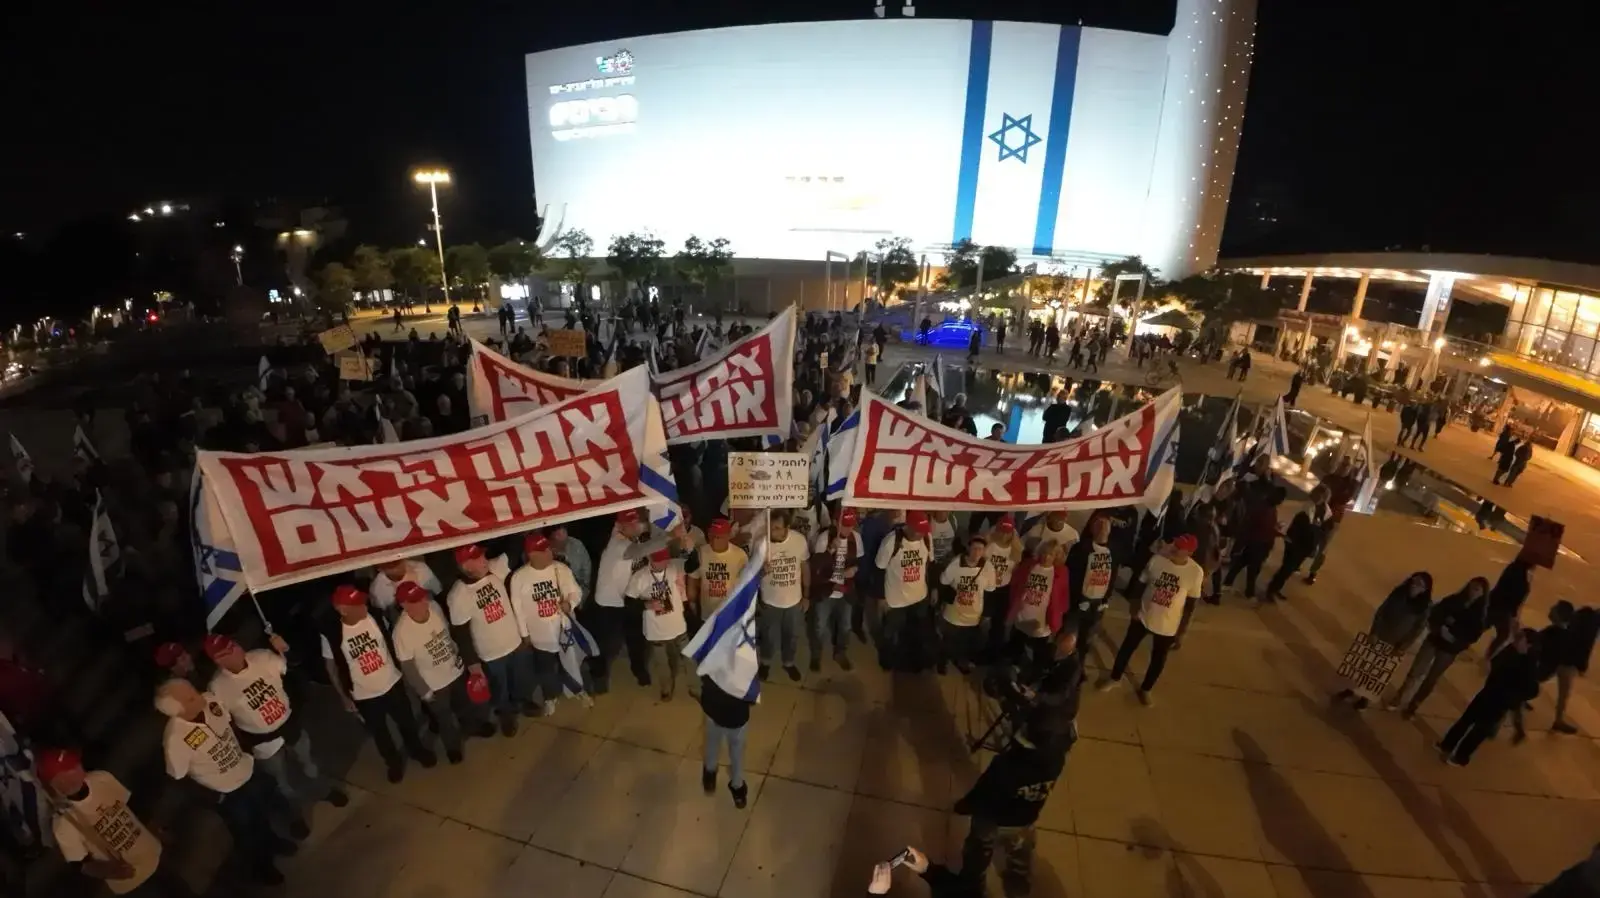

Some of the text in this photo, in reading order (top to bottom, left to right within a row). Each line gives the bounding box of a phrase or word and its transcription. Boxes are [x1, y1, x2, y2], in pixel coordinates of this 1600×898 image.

[661, 345, 763, 421] אתה
[667, 380, 768, 439] אתה
[876, 408, 1143, 469] אתה הראש
[243, 402, 619, 508] אתה הראש
[730, 456, 744, 466] 73
[779, 458, 807, 466] לוחמי
[868, 453, 1141, 500] אתה אשם
[730, 481, 754, 490] 2024
[269, 453, 634, 564] אתה אשם
[901, 558, 923, 567] הראש
[904, 550, 920, 559] אתה
[708, 563, 727, 571] אתה
[904, 567, 920, 575] אתה
[705, 572, 730, 581] הראש
[709, 580, 727, 588] אתה
[1030, 574, 1047, 583] אתה
[1160, 571, 1180, 584] אתה
[476, 582, 495, 599] אתה
[533, 580, 553, 592] אתה
[476, 590, 501, 609] הראש
[532, 588, 561, 602] הראש
[348, 631, 371, 649] אתה
[349, 639, 379, 659] הראש
[358, 649, 382, 667] אתה
[360, 660, 384, 676] אשם
[243, 677, 268, 699] אתה
[248, 684, 277, 710] הראש
[259, 695, 282, 716] אתה
[264, 704, 287, 725] אשם
